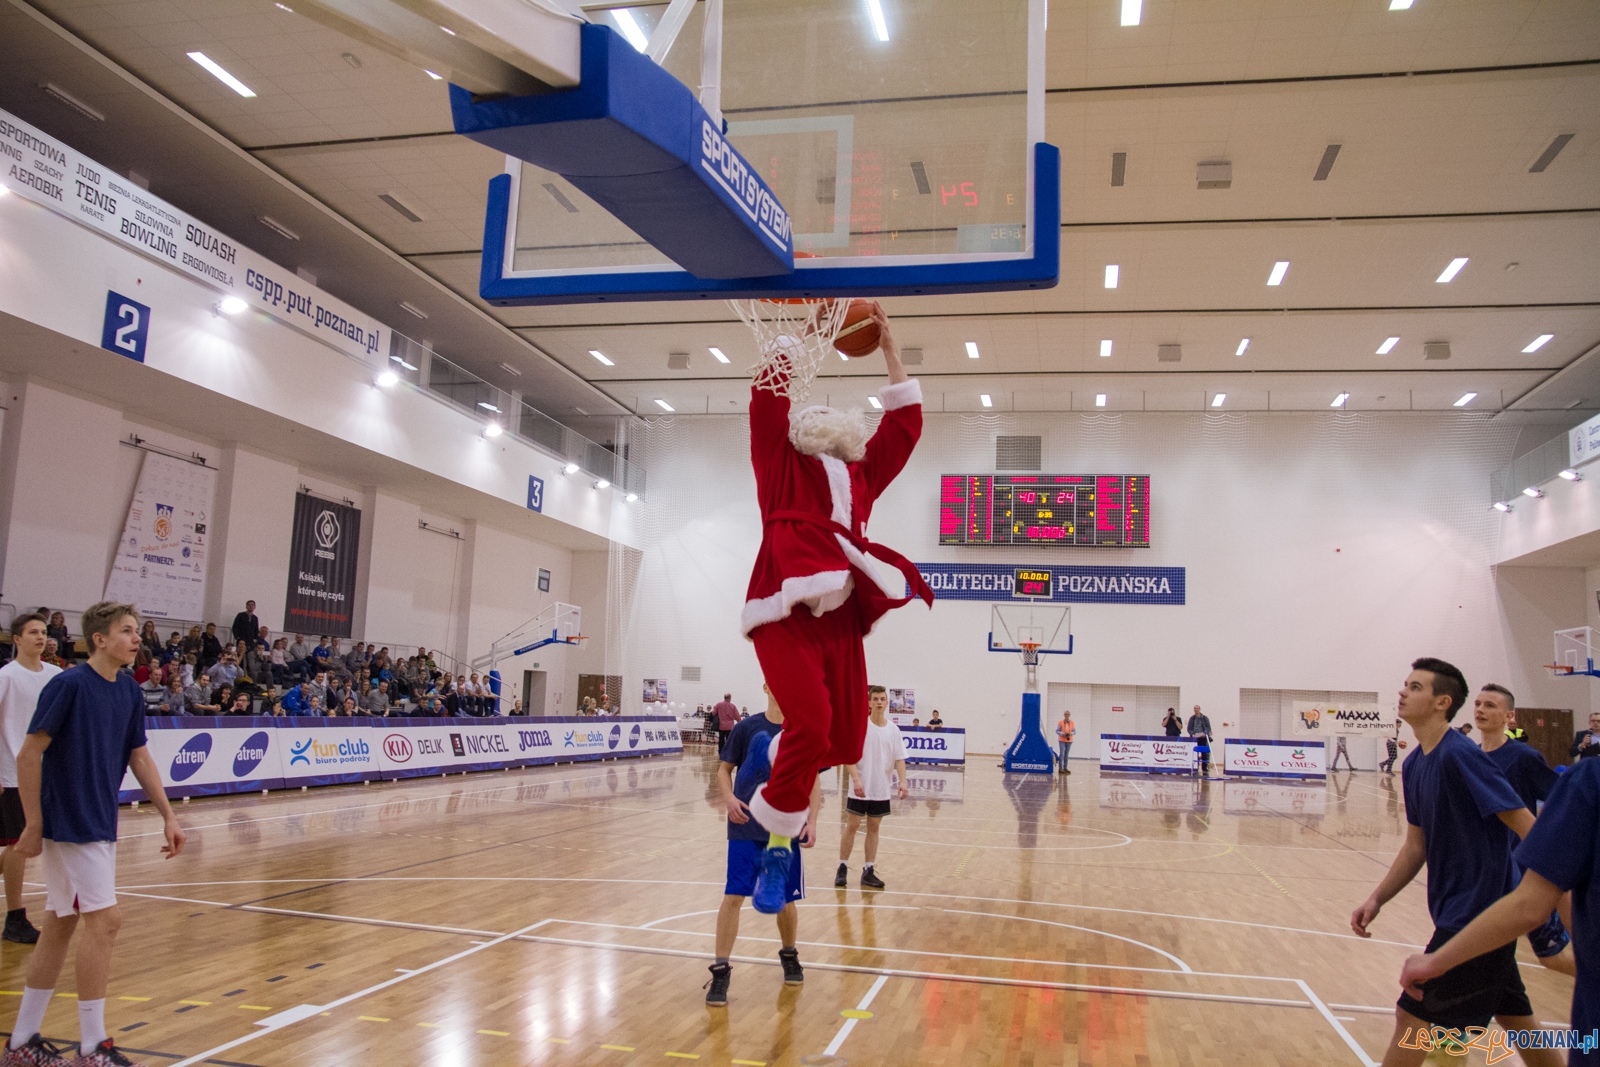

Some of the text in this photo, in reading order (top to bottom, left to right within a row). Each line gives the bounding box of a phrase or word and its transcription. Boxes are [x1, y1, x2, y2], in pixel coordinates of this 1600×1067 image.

[0, 121, 67, 168] SPORTOWA
[34, 160, 64, 181] SZACHY
[76, 163, 101, 185] JUDO
[9, 165, 63, 202] AEROBIK
[702, 120, 790, 242] SPORTSYSTEM
[75, 180, 117, 214] TENIS
[80, 203, 105, 222] KARATE
[120, 217, 178, 259] BOWLING
[186, 224, 237, 265] SQUASH
[245, 268, 380, 354] cspp.put.poznan.pl
[115, 303, 140, 353] 2
[532, 480, 542, 508] 3
[1056, 491, 1075, 504] 24
[922, 572, 1172, 594] POLITECHN POZNAŃSKA
[1023, 581, 1045, 594] 24
[297, 585, 345, 602] które się czyta
[1335, 710, 1381, 721] MAXXX
[236, 745, 264, 761] atrem
[312, 738, 370, 757] funclub
[417, 739, 445, 755] DELIK
[466, 734, 510, 754] NICKEL
[902, 736, 948, 751] oma
[175, 748, 207, 764] atrem
[315, 757, 338, 765] biuro
[1233, 759, 1270, 767] CYMES
[1280, 761, 1318, 769] CYMES
